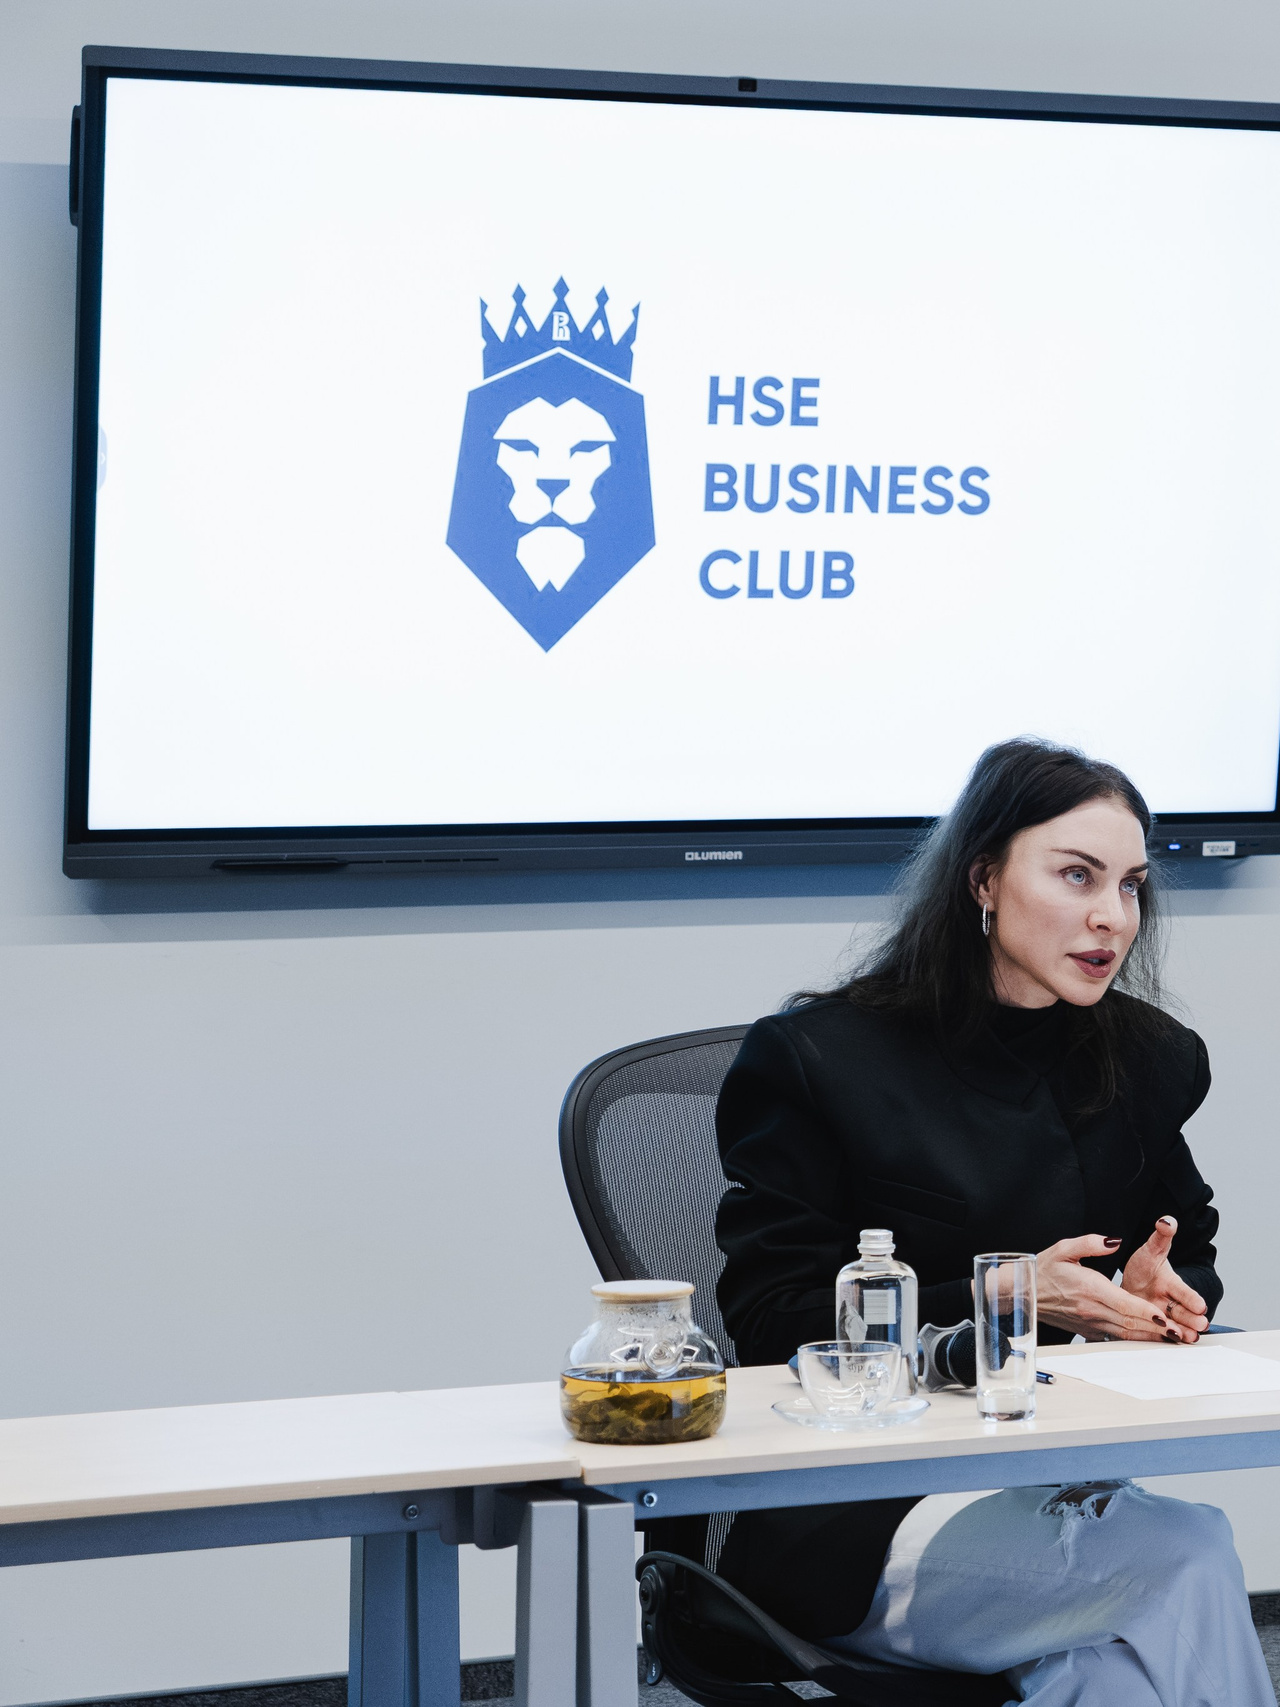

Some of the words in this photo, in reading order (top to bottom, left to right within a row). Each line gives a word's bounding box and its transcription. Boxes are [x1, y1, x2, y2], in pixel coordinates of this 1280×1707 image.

[707, 375, 821, 427] HSE
[703, 463, 990, 516] BUSINESS
[699, 549, 855, 600] CLUB
